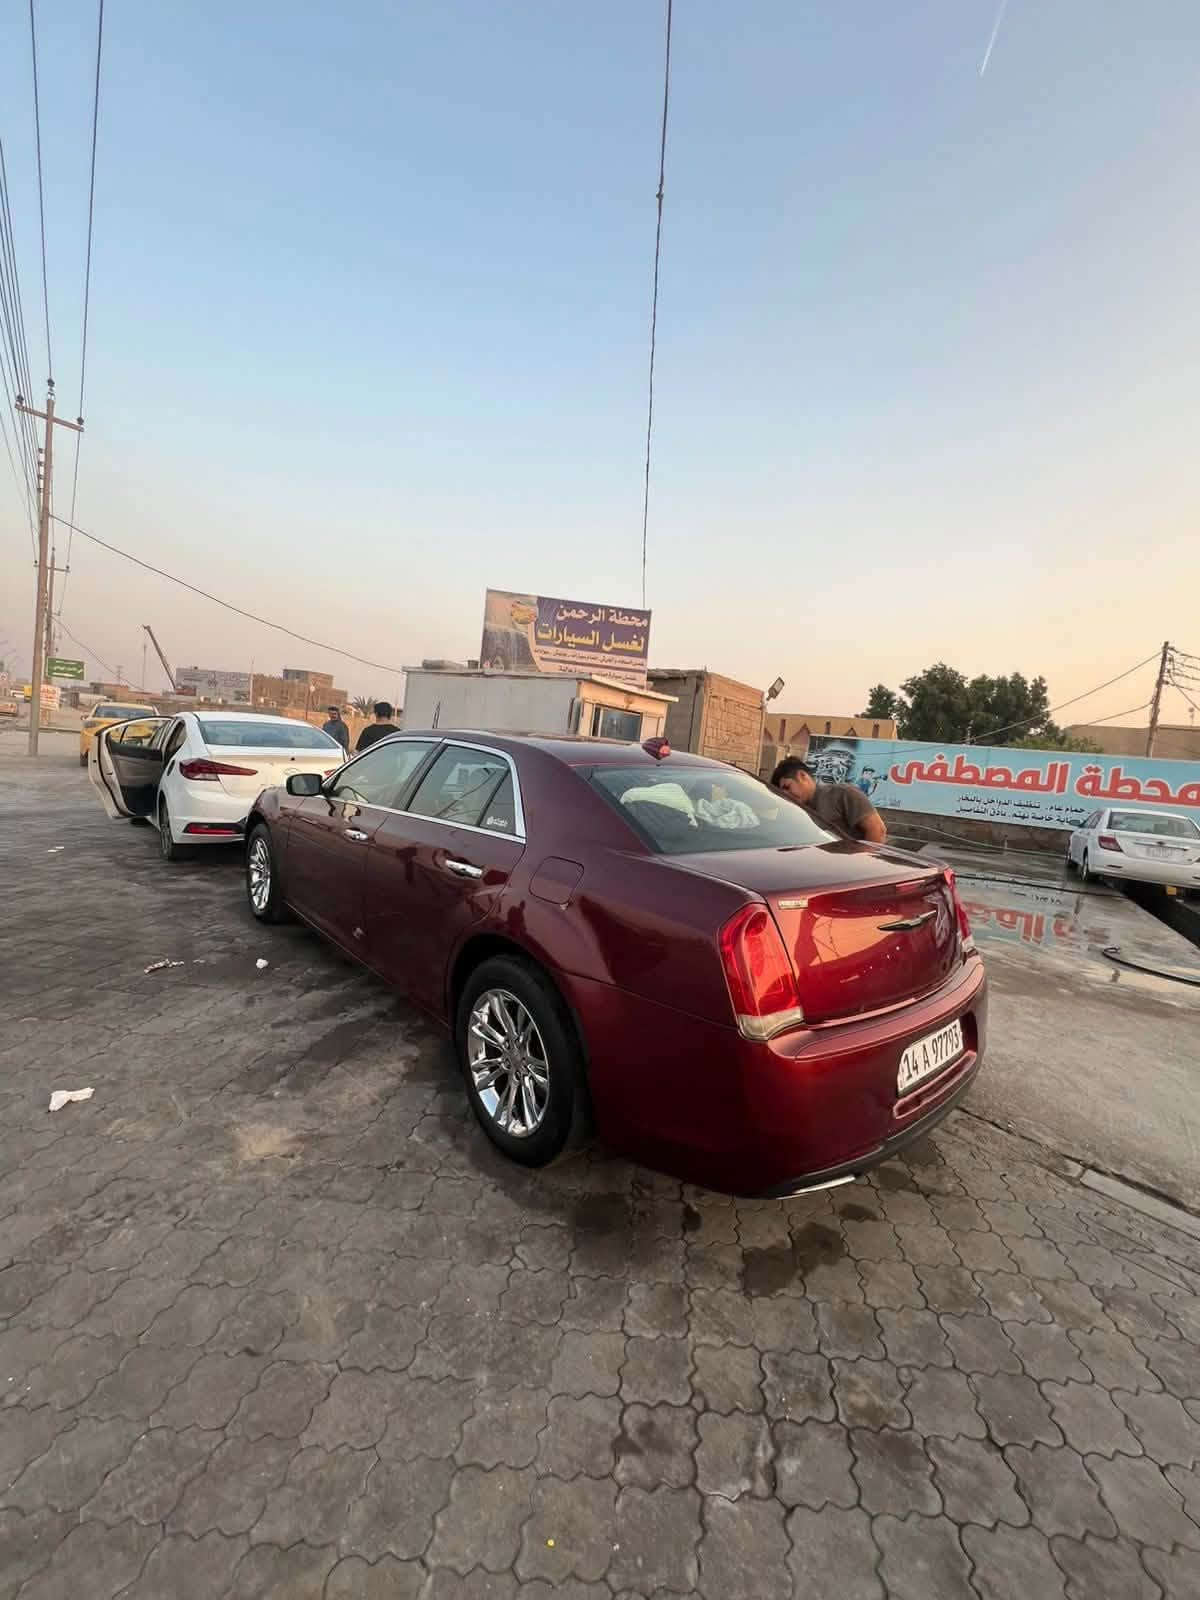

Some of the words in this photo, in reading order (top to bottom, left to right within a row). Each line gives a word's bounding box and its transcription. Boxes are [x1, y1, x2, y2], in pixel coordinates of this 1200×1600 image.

[556, 604, 605, 624] الرحمن
[609, 607, 648, 627] محطة
[537, 623, 600, 647] السيارات
[602, 632, 644, 651] لغسل
[890, 754, 1069, 794] المصطفى
[1075, 764, 1200, 806] محطة
[903, 1050, 919, 1080] 14
[922, 1043, 930, 1071] A
